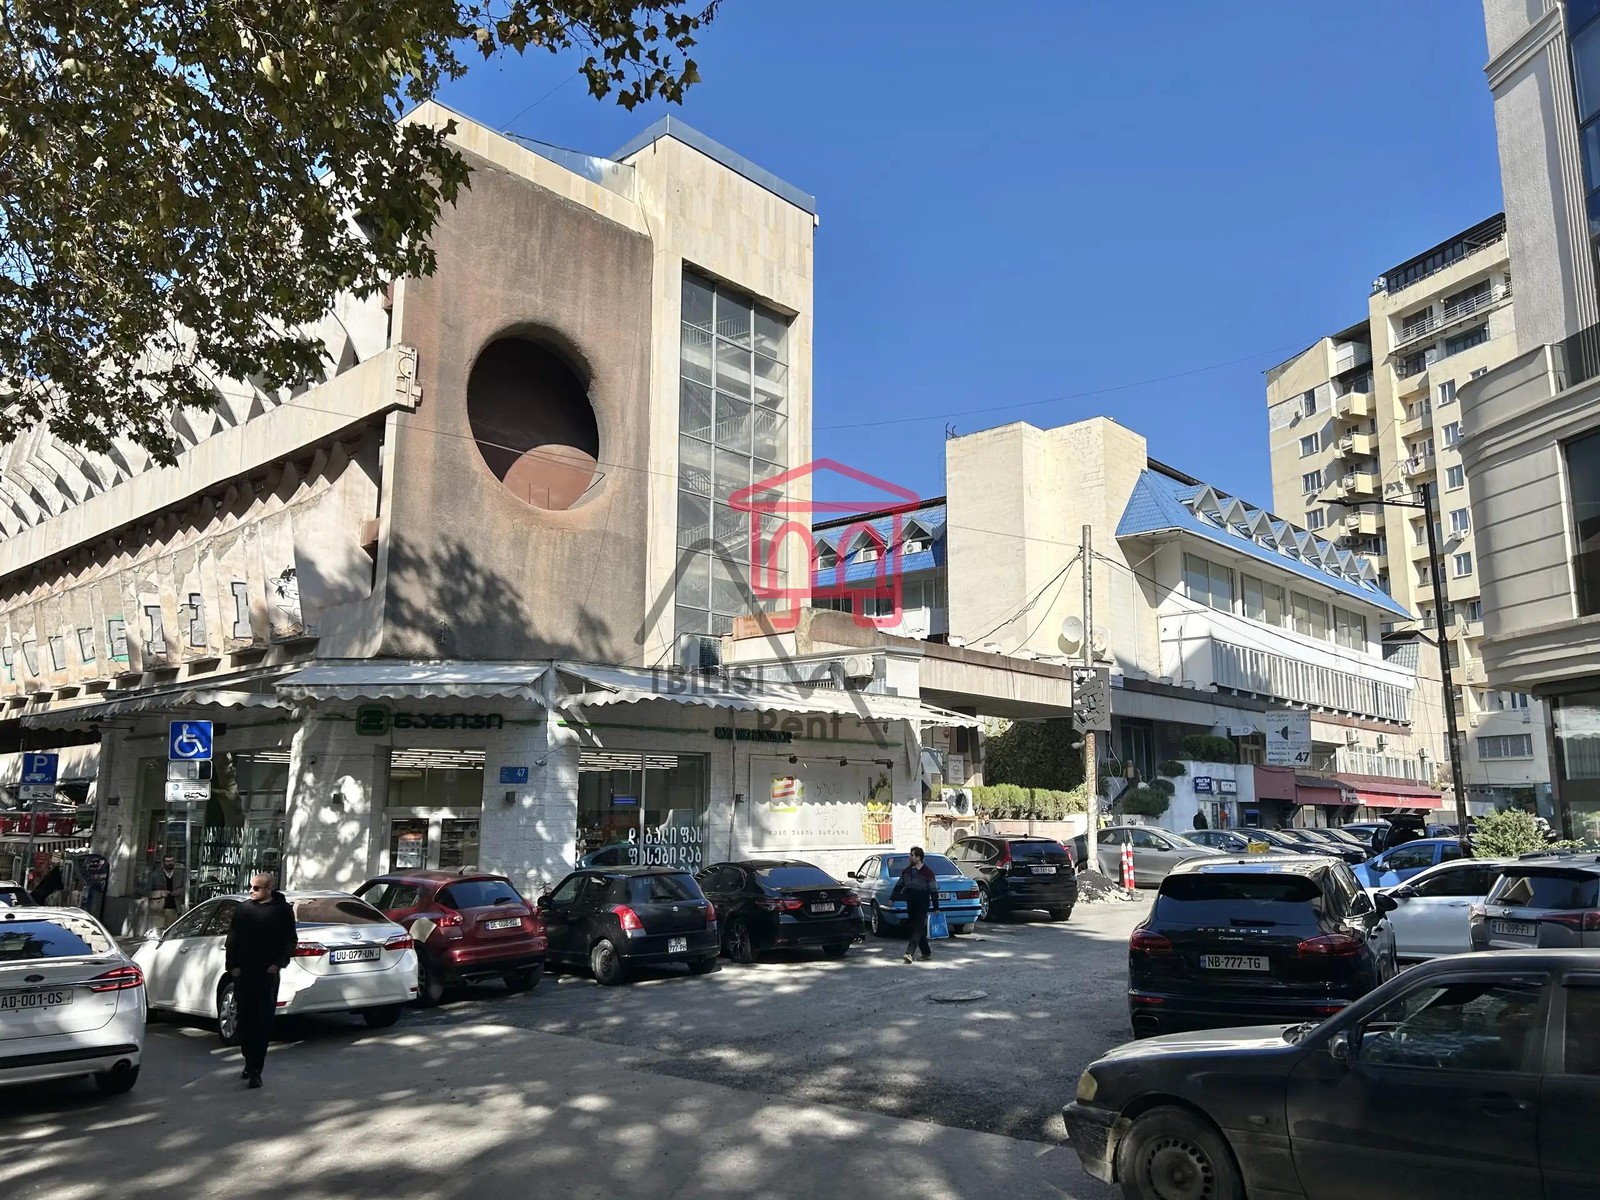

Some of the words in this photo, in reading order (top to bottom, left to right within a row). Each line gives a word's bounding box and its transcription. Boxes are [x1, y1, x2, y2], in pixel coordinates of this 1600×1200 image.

[1295, 752, 1310, 762] 47
[517, 768, 525, 777] 47
[336, 950, 375, 960] UU-077-UN
[1207, 956, 1261, 968] NB-777-TG
[1, 992, 63, 1009] AD-001-OS
